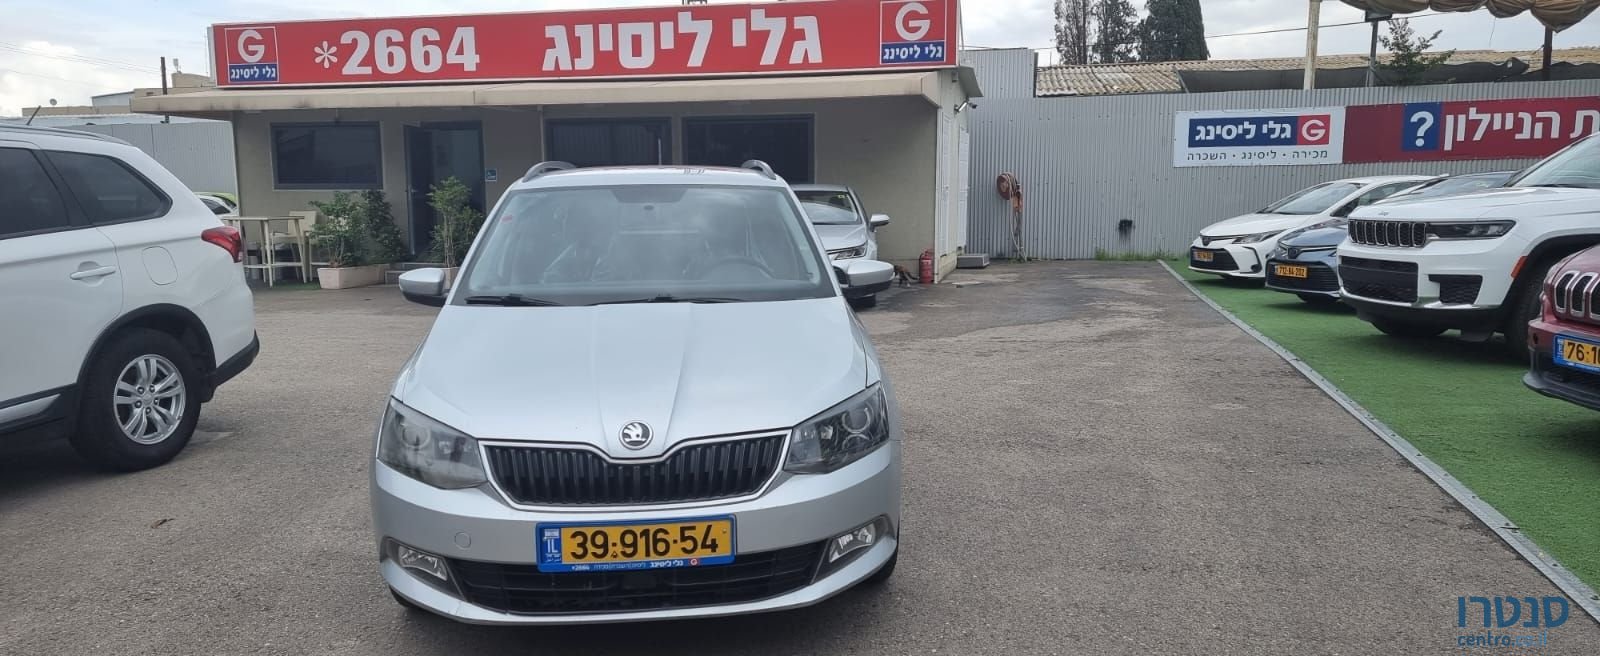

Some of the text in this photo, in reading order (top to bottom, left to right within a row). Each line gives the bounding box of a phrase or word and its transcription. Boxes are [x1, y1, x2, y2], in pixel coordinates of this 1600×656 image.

[895, 2, 931, 41] G
[237, 29, 265, 63] G
[542, 9, 823, 71] גלי ליסינג
[883, 44, 943, 60] גלי ליסינג
[230, 66, 276, 79] גלי ליסינג
[1195, 121, 1292, 141] גלי ליסינג
[1301, 119, 1326, 141] G
[1443, 107, 1561, 151] הניילון
[1187, 150, 1328, 161] מכירה ליסינג השכרה
[547, 538, 559, 553] IL
